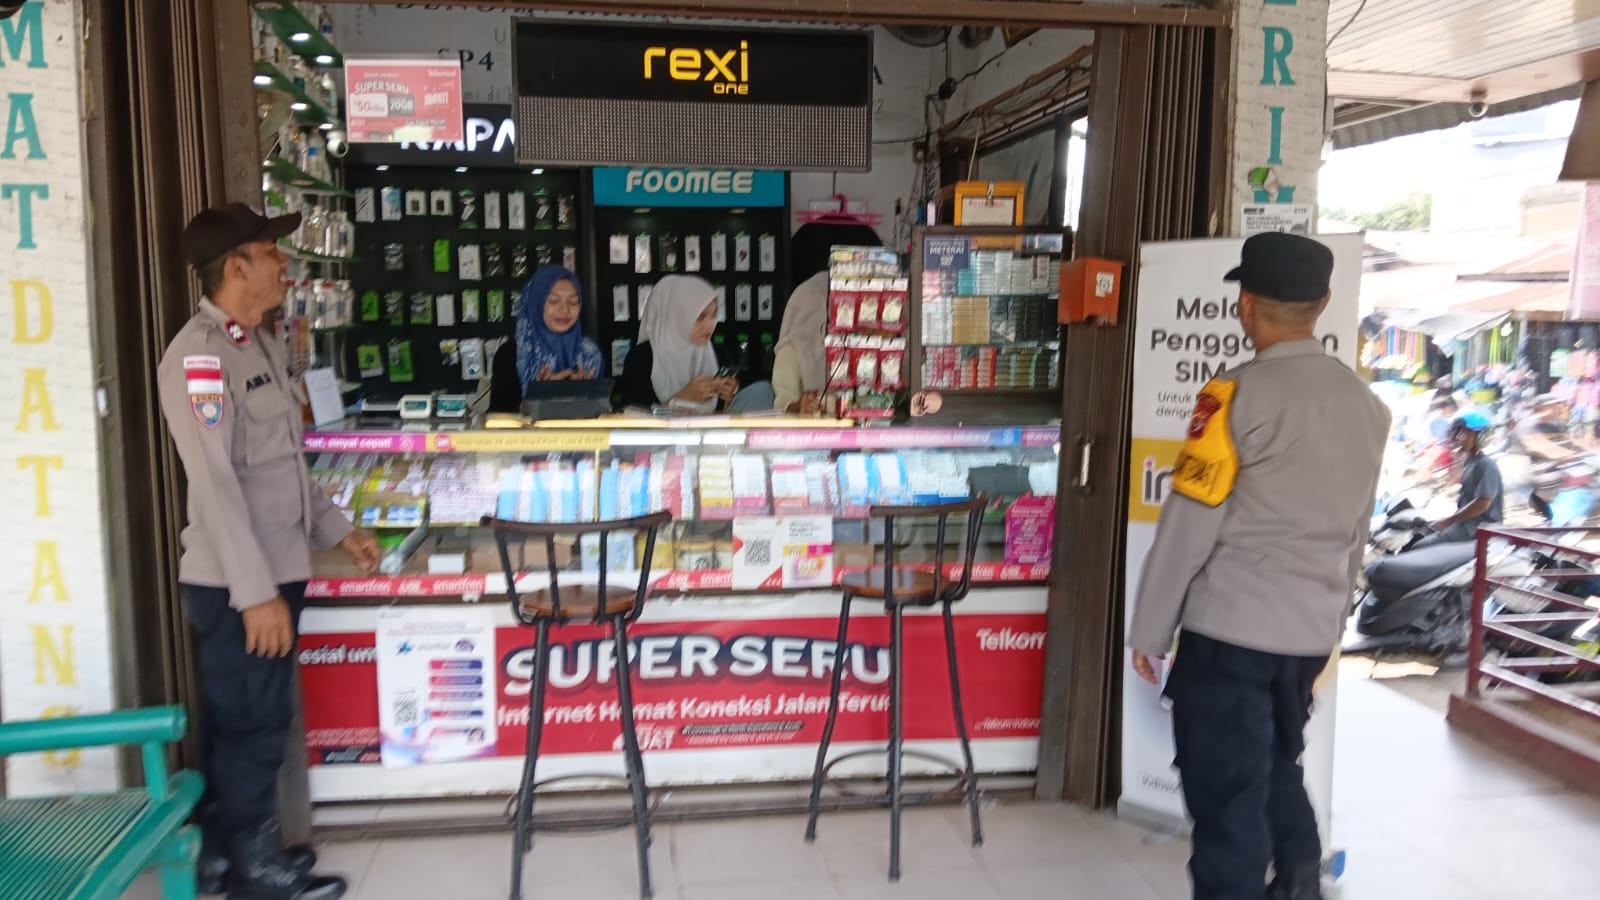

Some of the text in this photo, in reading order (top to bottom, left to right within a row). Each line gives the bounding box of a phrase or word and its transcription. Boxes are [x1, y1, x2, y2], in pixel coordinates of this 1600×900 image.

[644, 40, 749, 81] rexi
[355, 80, 385, 95] SUPER
[714, 83, 749, 95] one
[626, 170, 753, 194] FOOMEE
[680, 693, 771, 720] Koneksi
